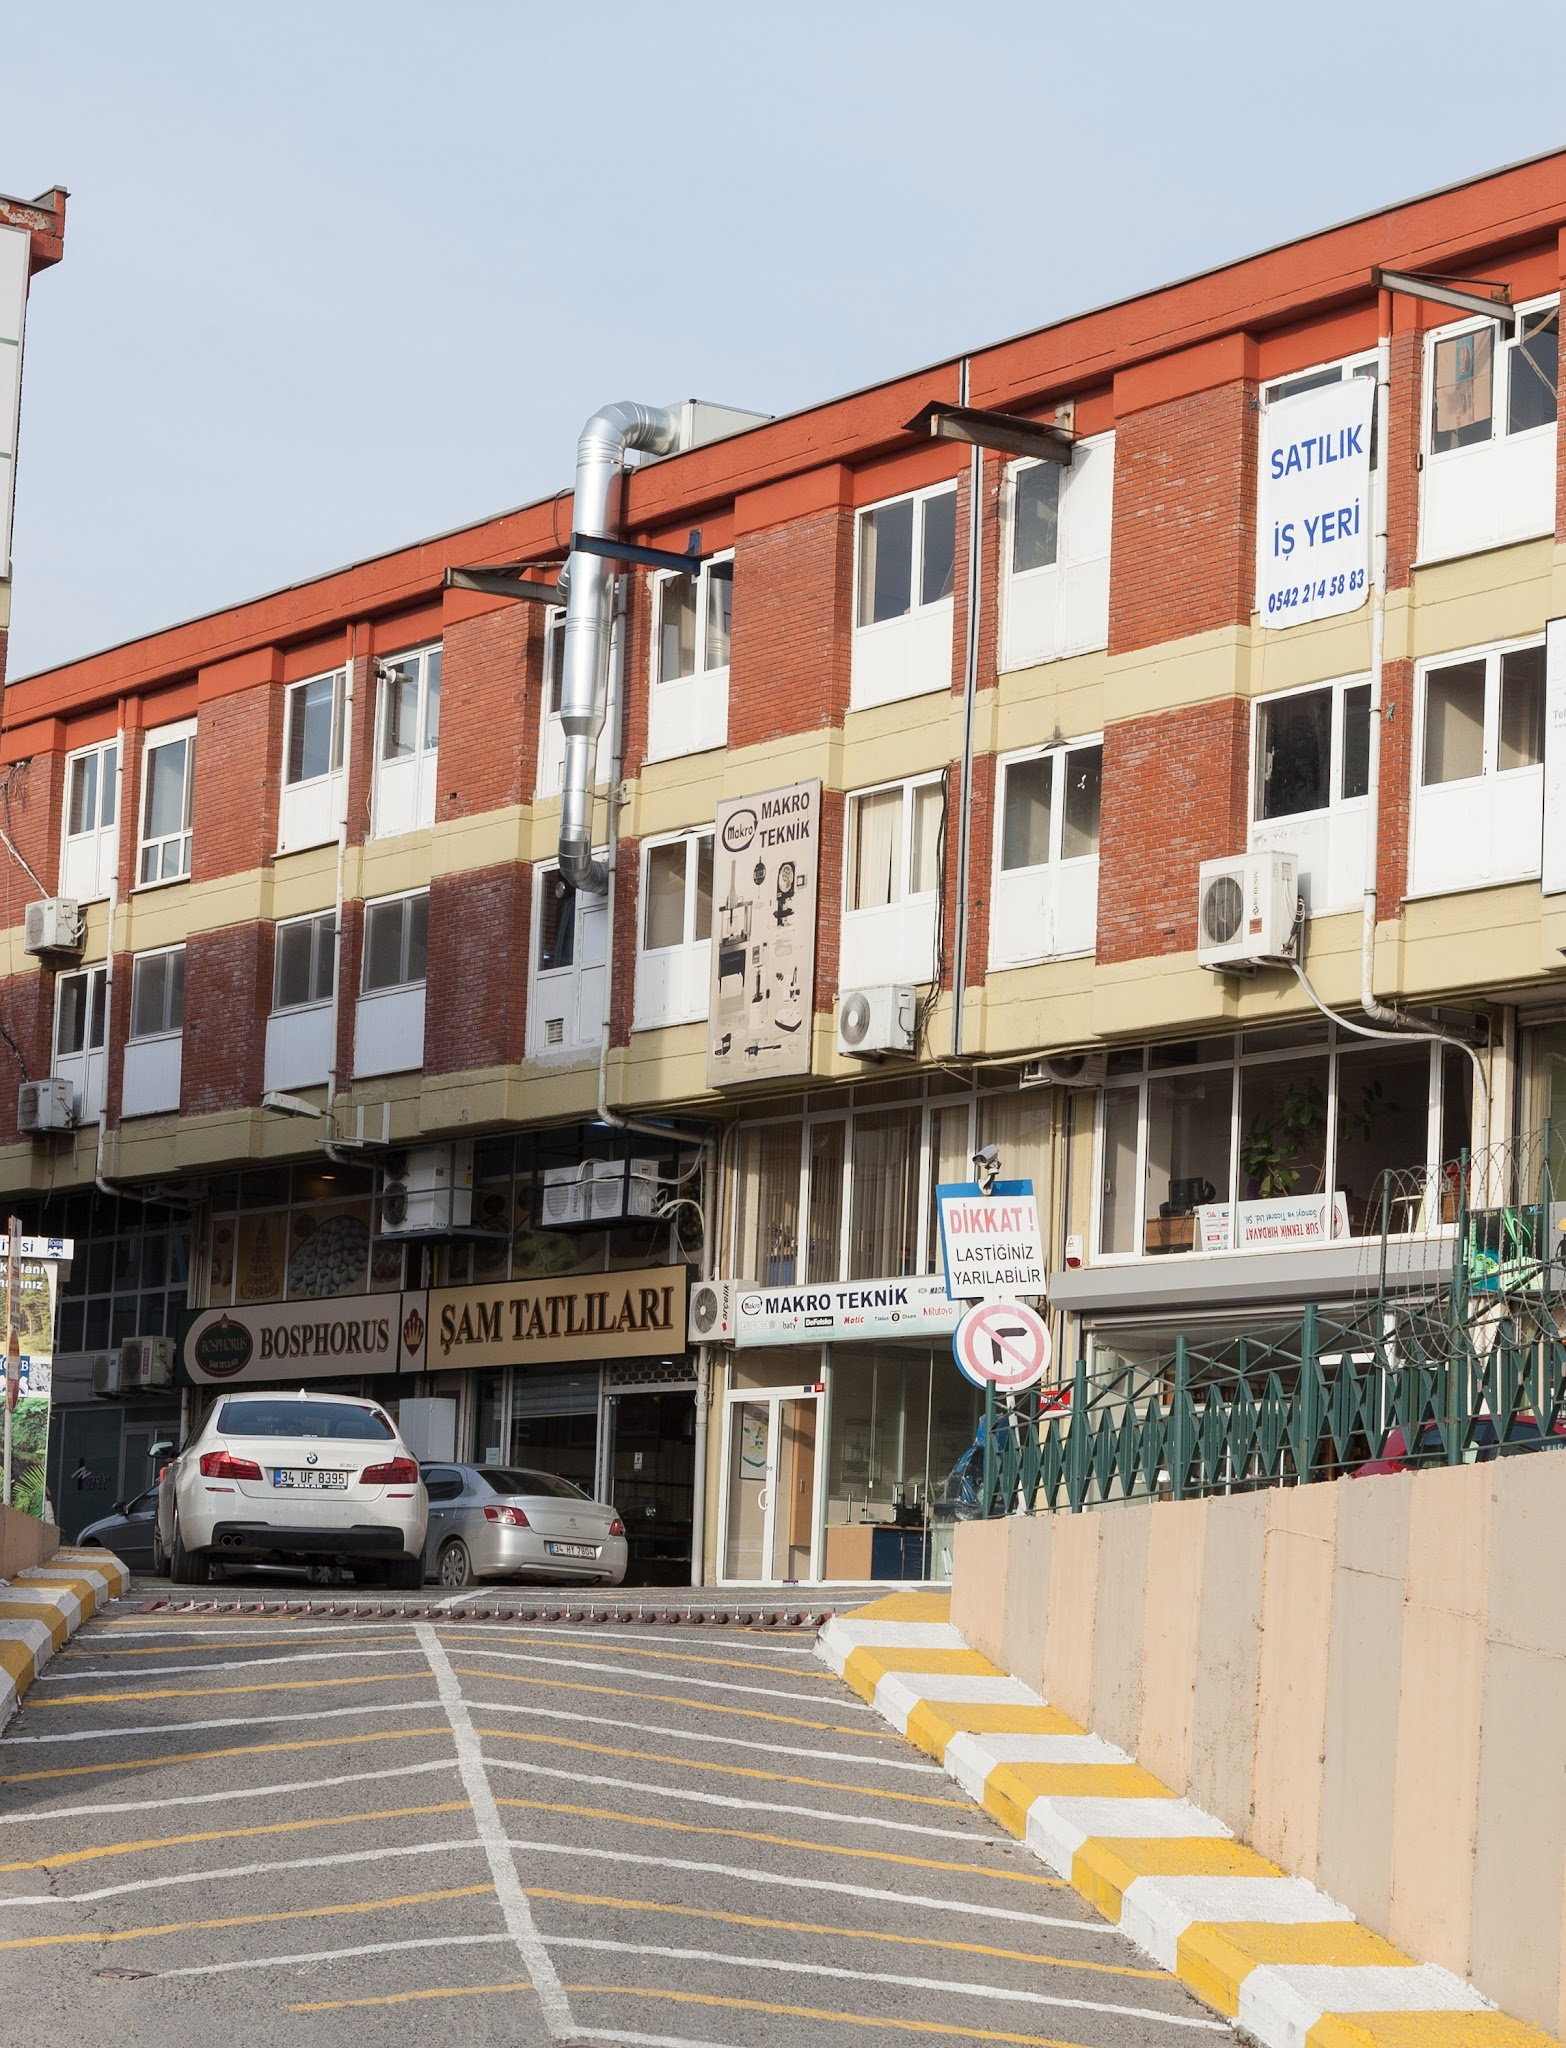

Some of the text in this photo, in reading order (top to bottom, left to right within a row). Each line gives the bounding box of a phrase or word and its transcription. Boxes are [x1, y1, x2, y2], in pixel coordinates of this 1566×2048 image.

[1271, 423, 1364, 480] SATILIK
[1274, 498, 1360, 561] İŞ YERİ
[1268, 568, 1365, 614] 0542 214 58 83
[761, 791, 810, 820] MAKRO
[727, 823, 754, 841] Makro
[759, 817, 810, 848] TEKNİK
[949, 1203, 1035, 1234] DİKKAT !
[1266, 1210, 1287, 1221] Ticaret
[1296, 1208, 1317, 1219] Sanayi
[1245, 1222, 1319, 1241] SUR TEKNİK HIRDAVAT
[956, 1243, 1034, 1262] LASTİĞİNİZ
[953, 1266, 1042, 1286] YARILABİLİR
[765, 1284, 908, 1314] MAKRO TEKNİK
[440, 1286, 674, 1355] ŞAM TATLILARI
[259, 1319, 390, 1360] BOSPHORUS
[281, 1471, 345, 1484] 34 UF 8395
